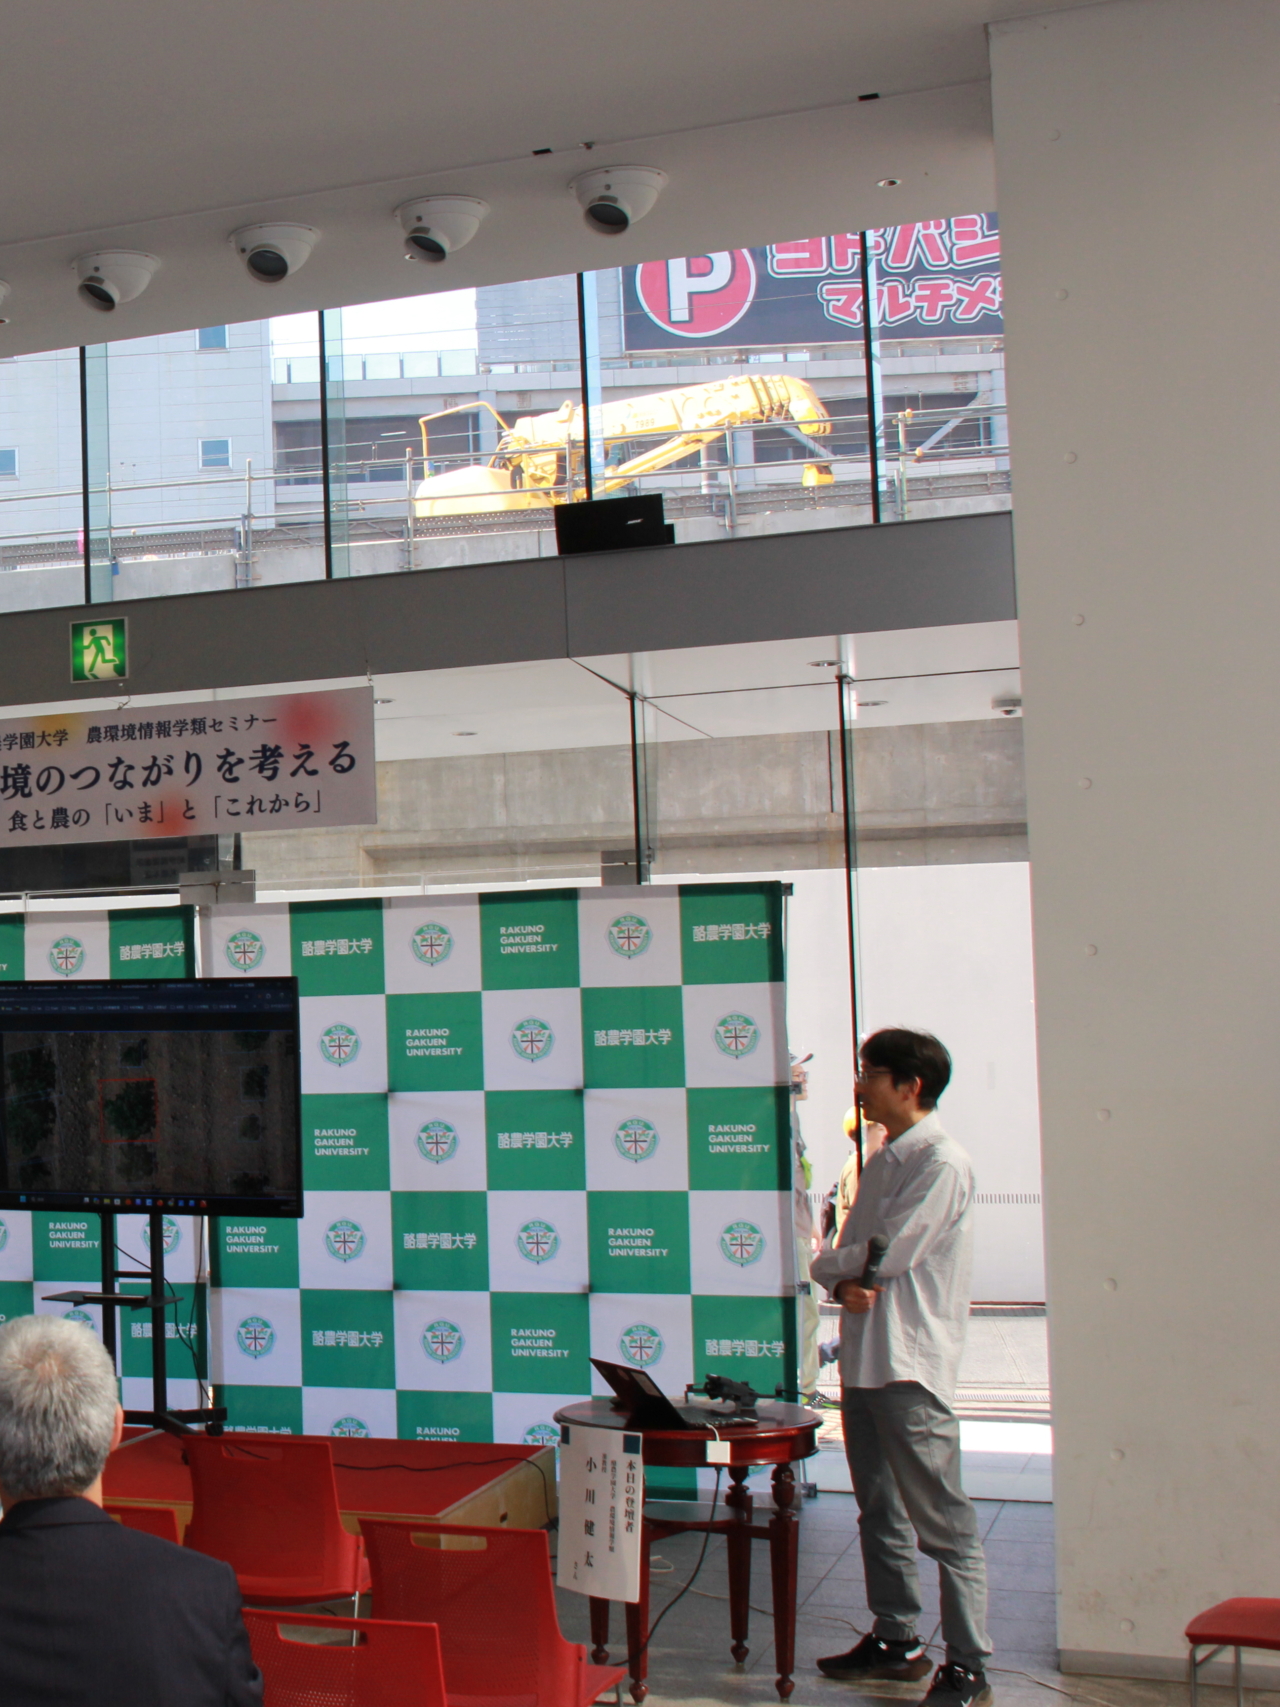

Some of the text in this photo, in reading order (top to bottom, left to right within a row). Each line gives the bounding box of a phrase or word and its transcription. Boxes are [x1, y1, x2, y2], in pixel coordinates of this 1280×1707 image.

[668, 252, 732, 322] P
[819, 277, 1001, 328] マルチメ
[86, 714, 277, 745] 農環境情報学類セミナー
[8, 791, 323, 832] 食と農の「いま」と「これから」
[500, 925, 544, 934] RAKUNO
[692, 922, 771, 942] 酪農学園大学
[500, 935, 542, 944] GAKUEN
[120, 941, 184, 960] 酪農学園大学
[302, 938, 373, 956] 酪農学園大学
[500, 944, 558, 954] UNIVERSITY
[405, 1028, 450, 1037] RAKUNO
[406, 1038, 447, 1046] GAKUEN
[594, 1029, 672, 1047] 酪農学園大学
[406, 1047, 463, 1057] UNIVERSITY
[708, 1124, 756, 1132] RAKUNO
[497, 1132, 573, 1149] 酪農学園大学
[709, 1135, 753, 1143] GAKUEN
[314, 1148, 369, 1156] UNIVERSITY
[709, 1145, 770, 1153] UNIVERSITY
[226, 1226, 267, 1234] RAKUNO
[608, 1228, 654, 1236] RAKUNO
[404, 1233, 477, 1249] 酪農学園大学
[608, 1238, 652, 1246] GAKUEN
[608, 1248, 668, 1257] UNIVERSITY
[131, 1322, 197, 1339] 酪農園大学
[510, 1329, 556, 1338] RAKUNO
[312, 1331, 384, 1348] 酪農学園大学
[511, 1339, 553, 1347] GAKUEN
[511, 1349, 569, 1358] UNIVERSITY
[705, 1340, 784, 1358] 酪農学園大学
[416, 1427, 460, 1436] RAKUNO
[624, 1459, 637, 1533] 本日の登壇者
[584, 1457, 597, 1568] 小川健太
